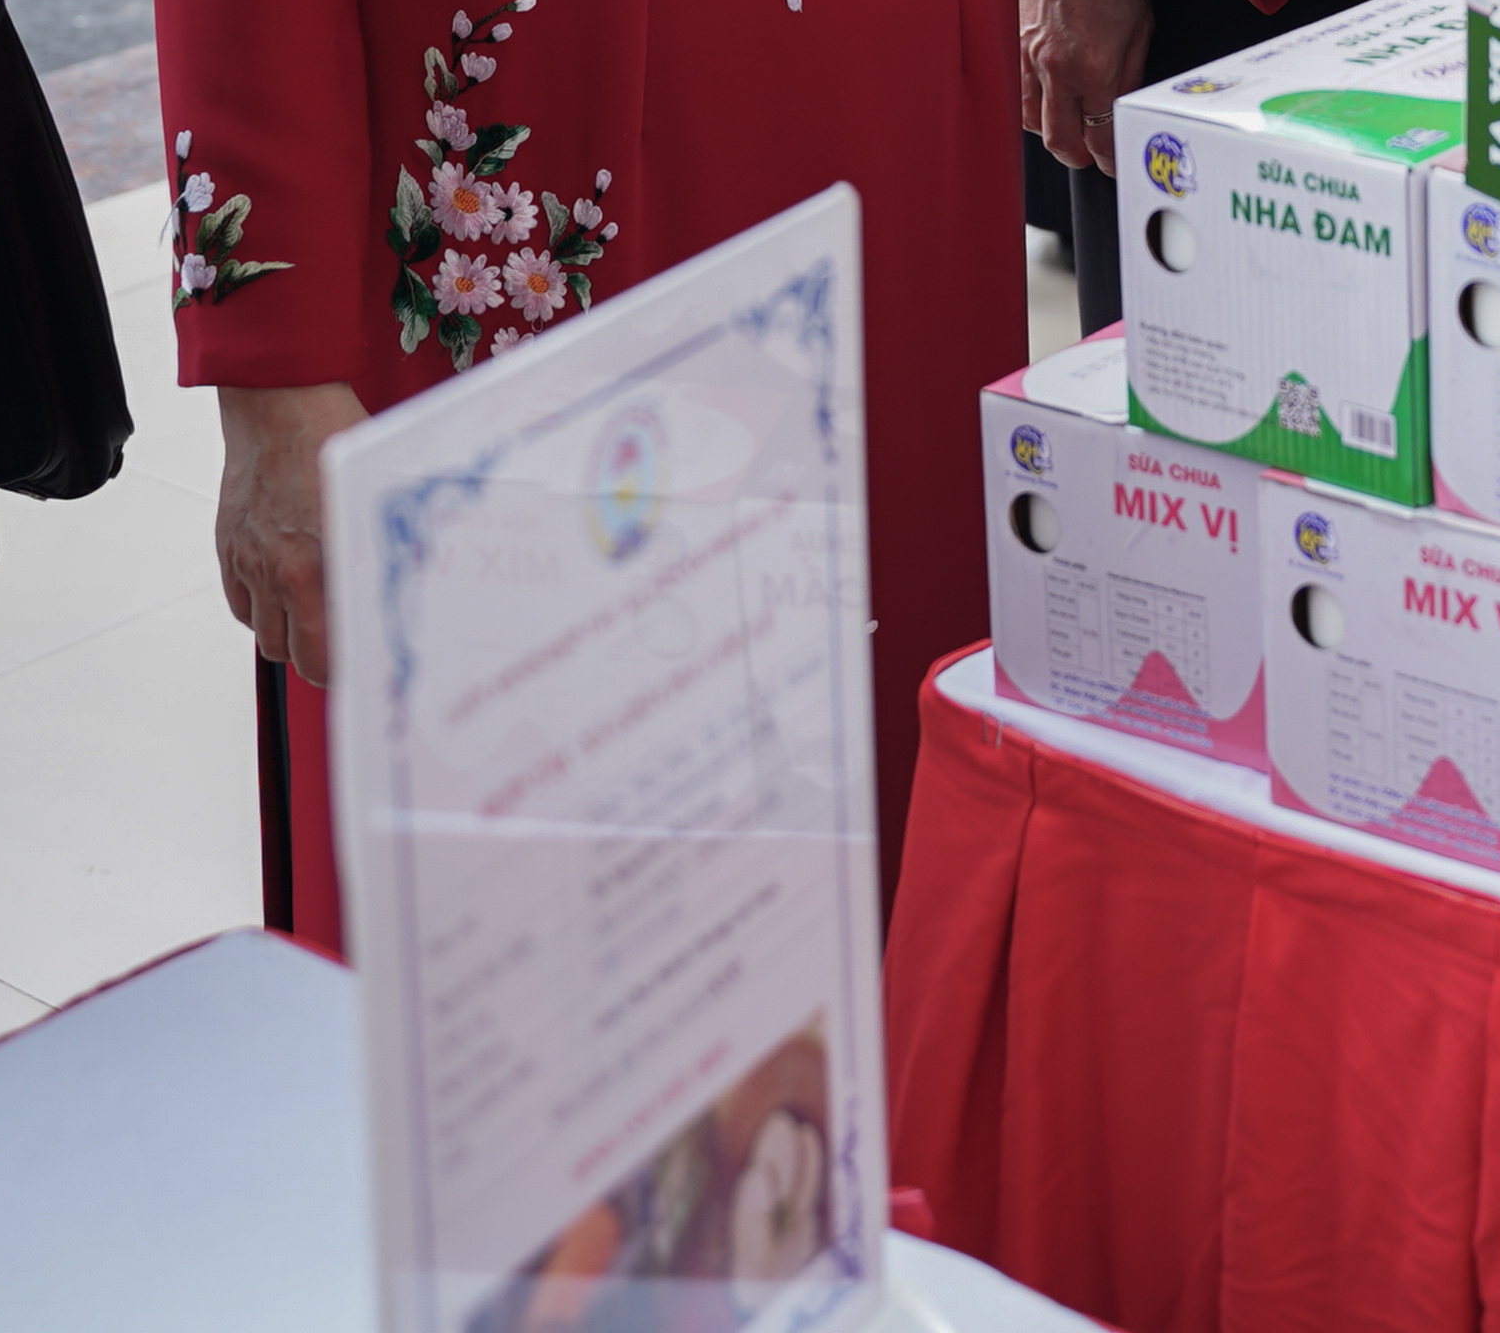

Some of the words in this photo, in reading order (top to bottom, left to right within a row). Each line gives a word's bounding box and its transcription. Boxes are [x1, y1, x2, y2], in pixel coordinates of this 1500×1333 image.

[1257, 158, 1296, 190] SỮA
[1303, 170, 1361, 202] CHUA
[1230, 190, 1303, 237] NHA
[1313, 214, 1392, 257] ĐAM
[1127, 451, 1167, 476] SỮA
[1172, 464, 1223, 491] CHUA
[1113, 481, 1189, 532] MIX
[1202, 505, 1241, 554] VỊ
[1419, 543, 1459, 574] SỮA
[1402, 576, 1482, 632] MIX
